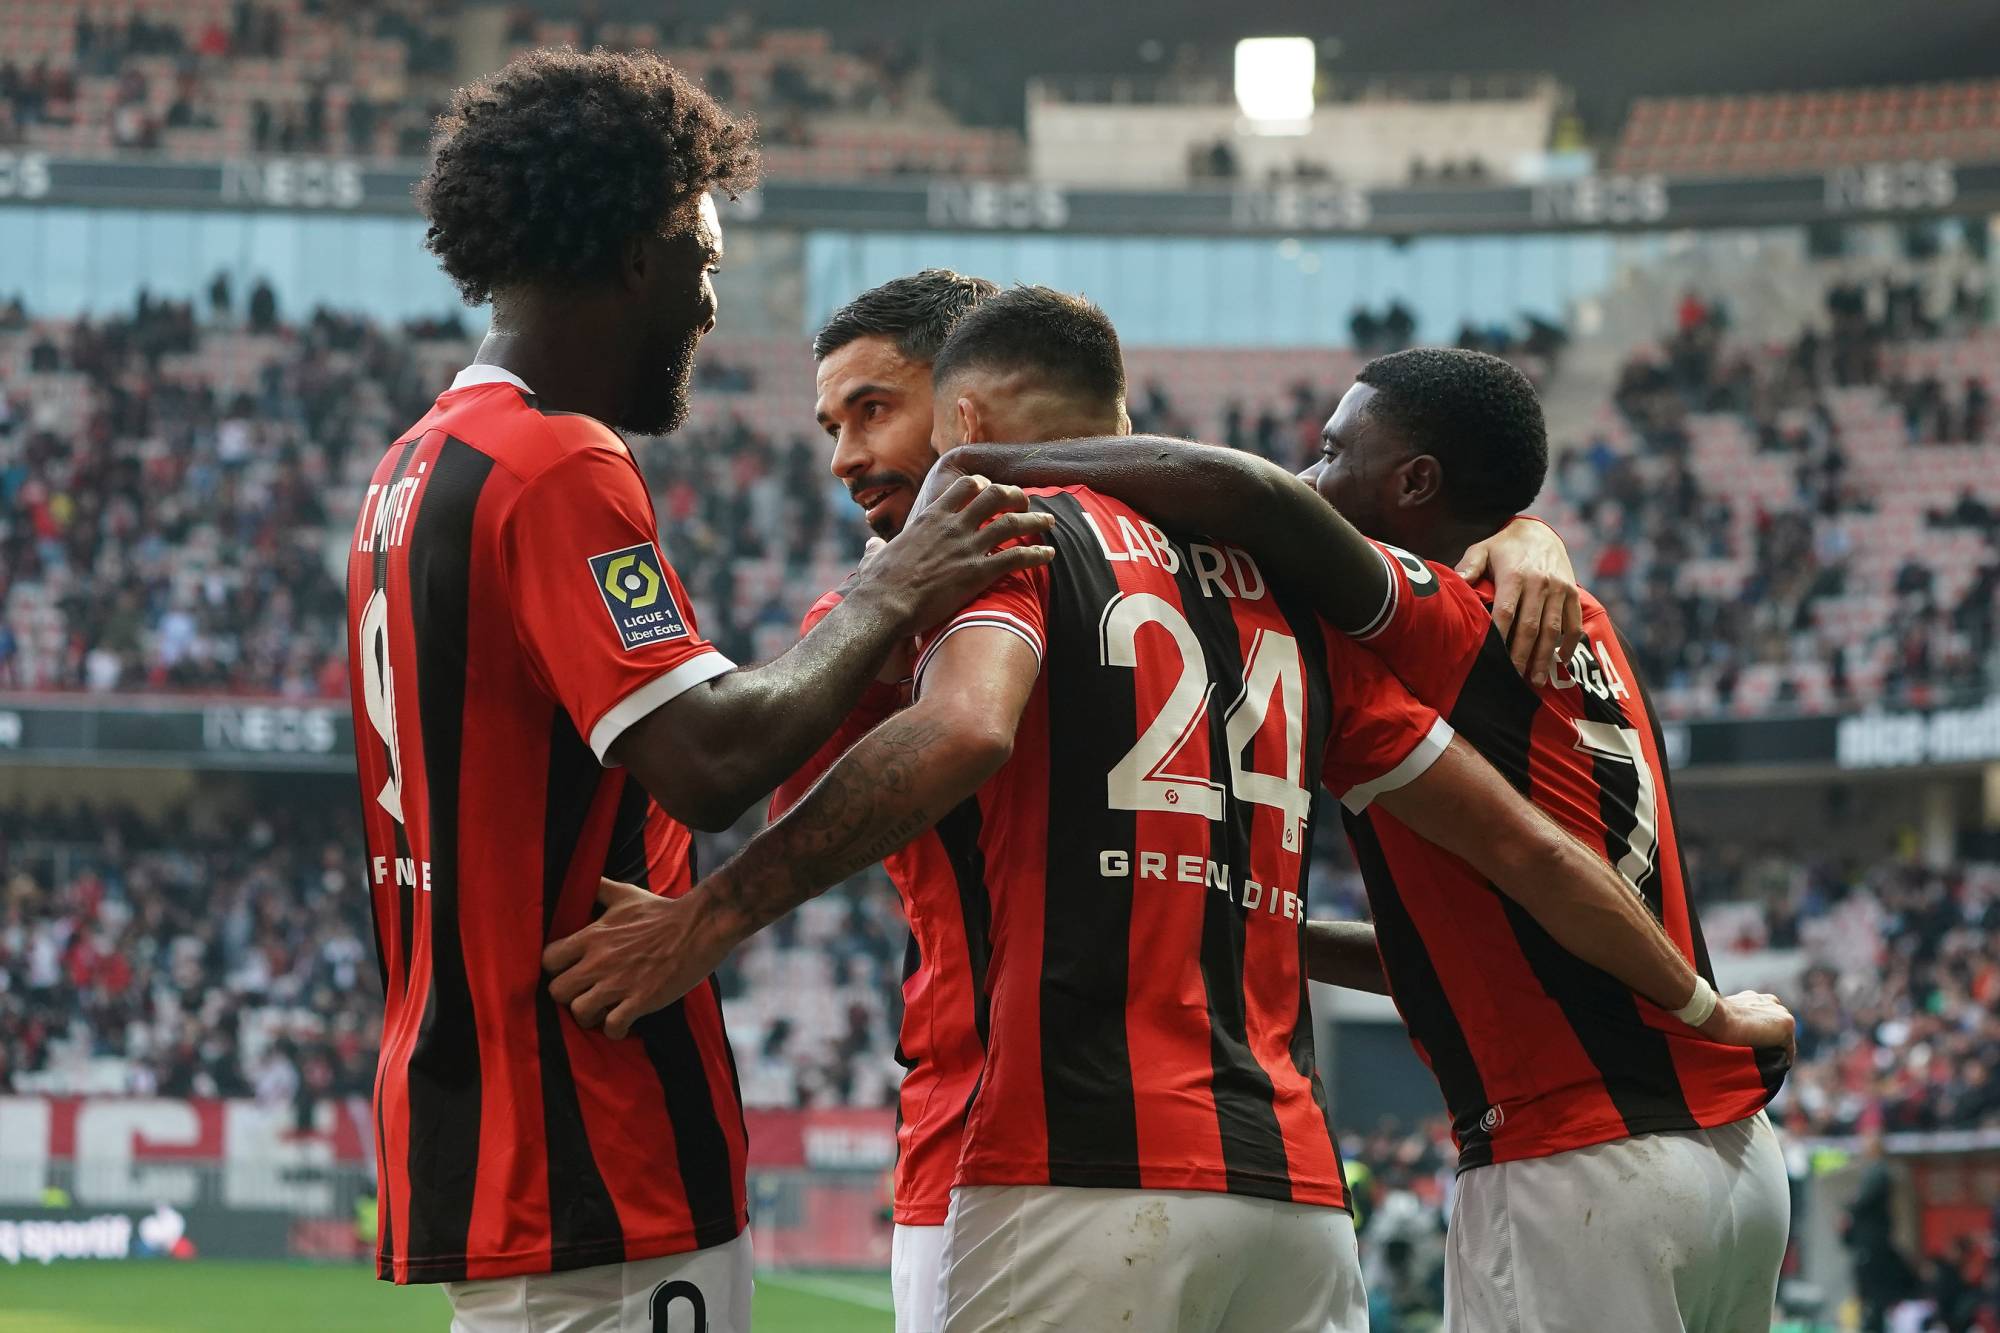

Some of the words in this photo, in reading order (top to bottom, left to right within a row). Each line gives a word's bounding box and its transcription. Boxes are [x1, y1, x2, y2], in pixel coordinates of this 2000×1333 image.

[1081, 512, 1265, 600] LABRD
[624, 612, 664, 628] LIGUE
[665, 609, 673, 619] 1
[626, 631, 654, 642] Uber
[654, 623, 682, 636] Eats
[1099, 591, 1311, 855] 24
[1569, 717, 1659, 900] 7
